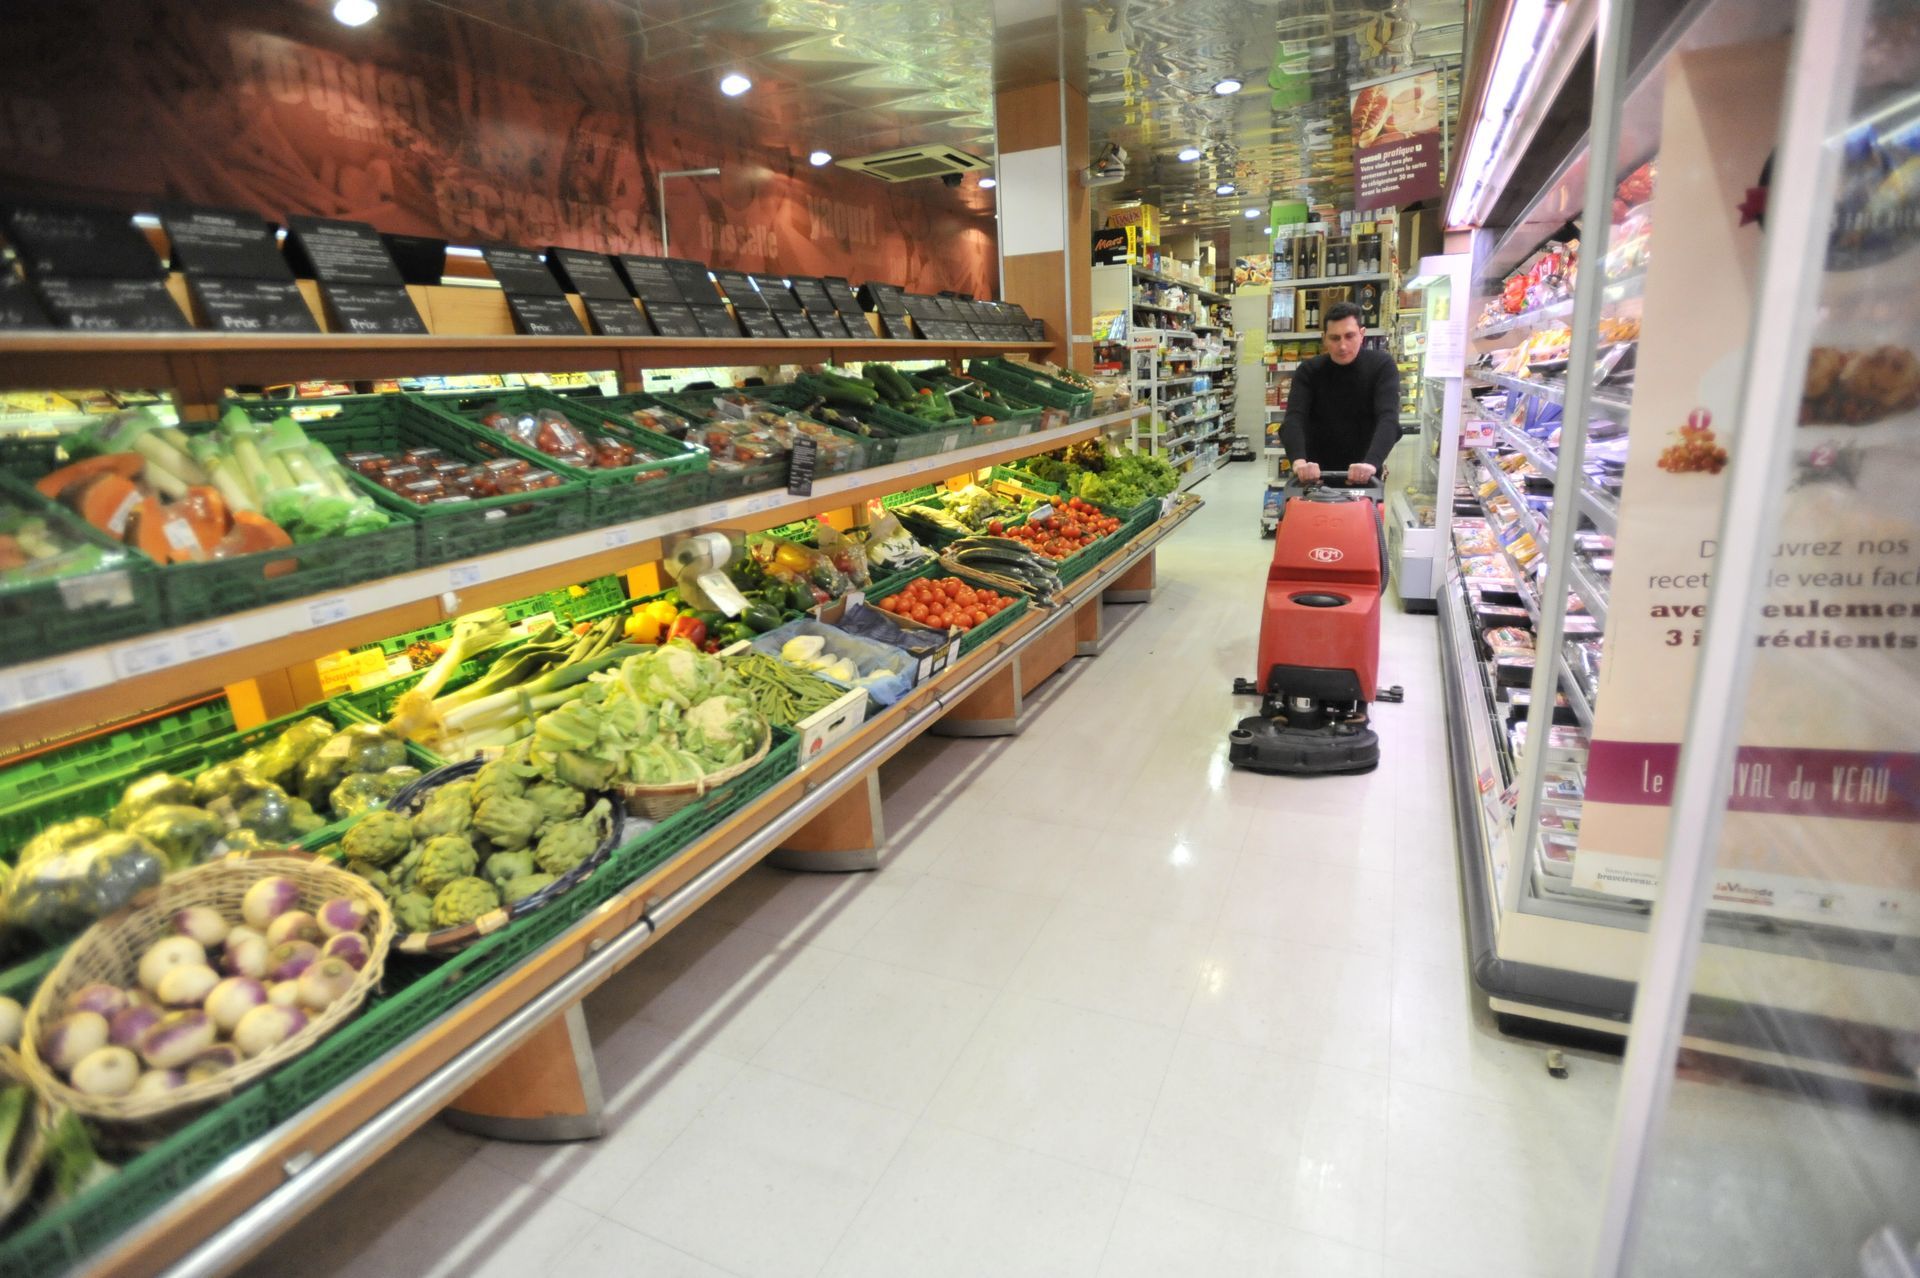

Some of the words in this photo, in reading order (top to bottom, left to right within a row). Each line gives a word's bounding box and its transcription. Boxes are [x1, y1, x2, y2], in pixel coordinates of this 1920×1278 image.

[1383, 145, 1415, 161] pratique
[1111, 210, 1141, 227] Twix
[1095, 236, 1124, 251] Mars
[1858, 539, 1910, 555] nos
[1798, 571, 1863, 587] veau
[1665, 629, 1682, 647] 3
[1642, 758, 1664, 793] le
[1788, 765, 1816, 801] du
[1831, 766, 1891, 806] VEAU
